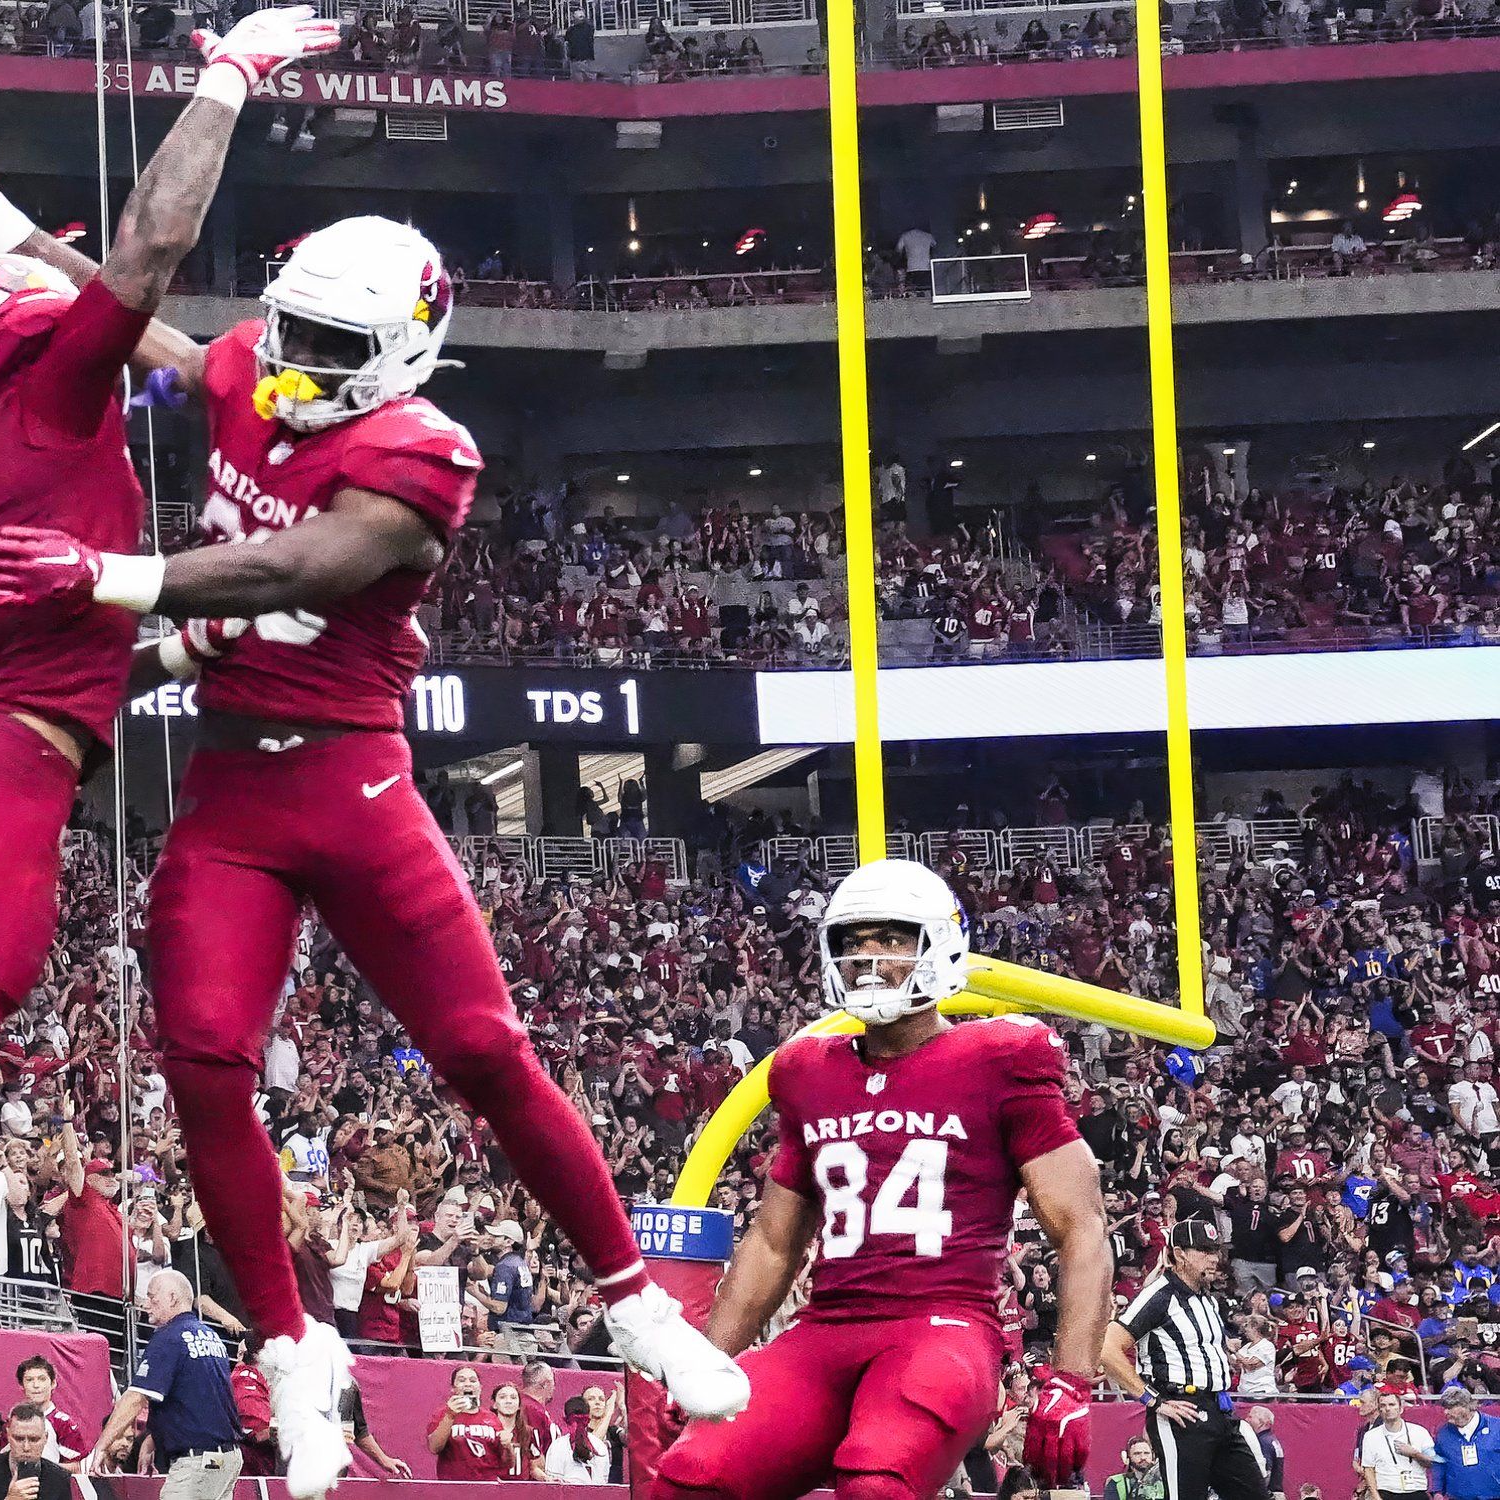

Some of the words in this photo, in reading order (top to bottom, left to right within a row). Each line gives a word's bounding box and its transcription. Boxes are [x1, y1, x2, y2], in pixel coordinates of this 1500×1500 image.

[94, 62, 133, 92] 35
[144, 64, 303, 98] AEAS
[315, 73, 508, 107] WILLIAMS
[944, 617, 959, 633] 10
[411, 675, 466, 734] 110
[526, 691, 603, 724] TDS
[619, 678, 640, 735] 1
[1120, 847, 1133, 862] 9
[658, 964, 670, 980] 11
[1365, 960, 1383, 978] 10
[1478, 974, 1500, 993] 40
[804, 1110, 968, 1146] ARIZONA
[1291, 1159, 1316, 1180] 10
[814, 1138, 953, 1259] 84
[1370, 1202, 1390, 1225] 13
[631, 1214, 702, 1235] HOOSE
[639, 1233, 685, 1253] OVE
[1334, 1343, 1356, 1366] 85
